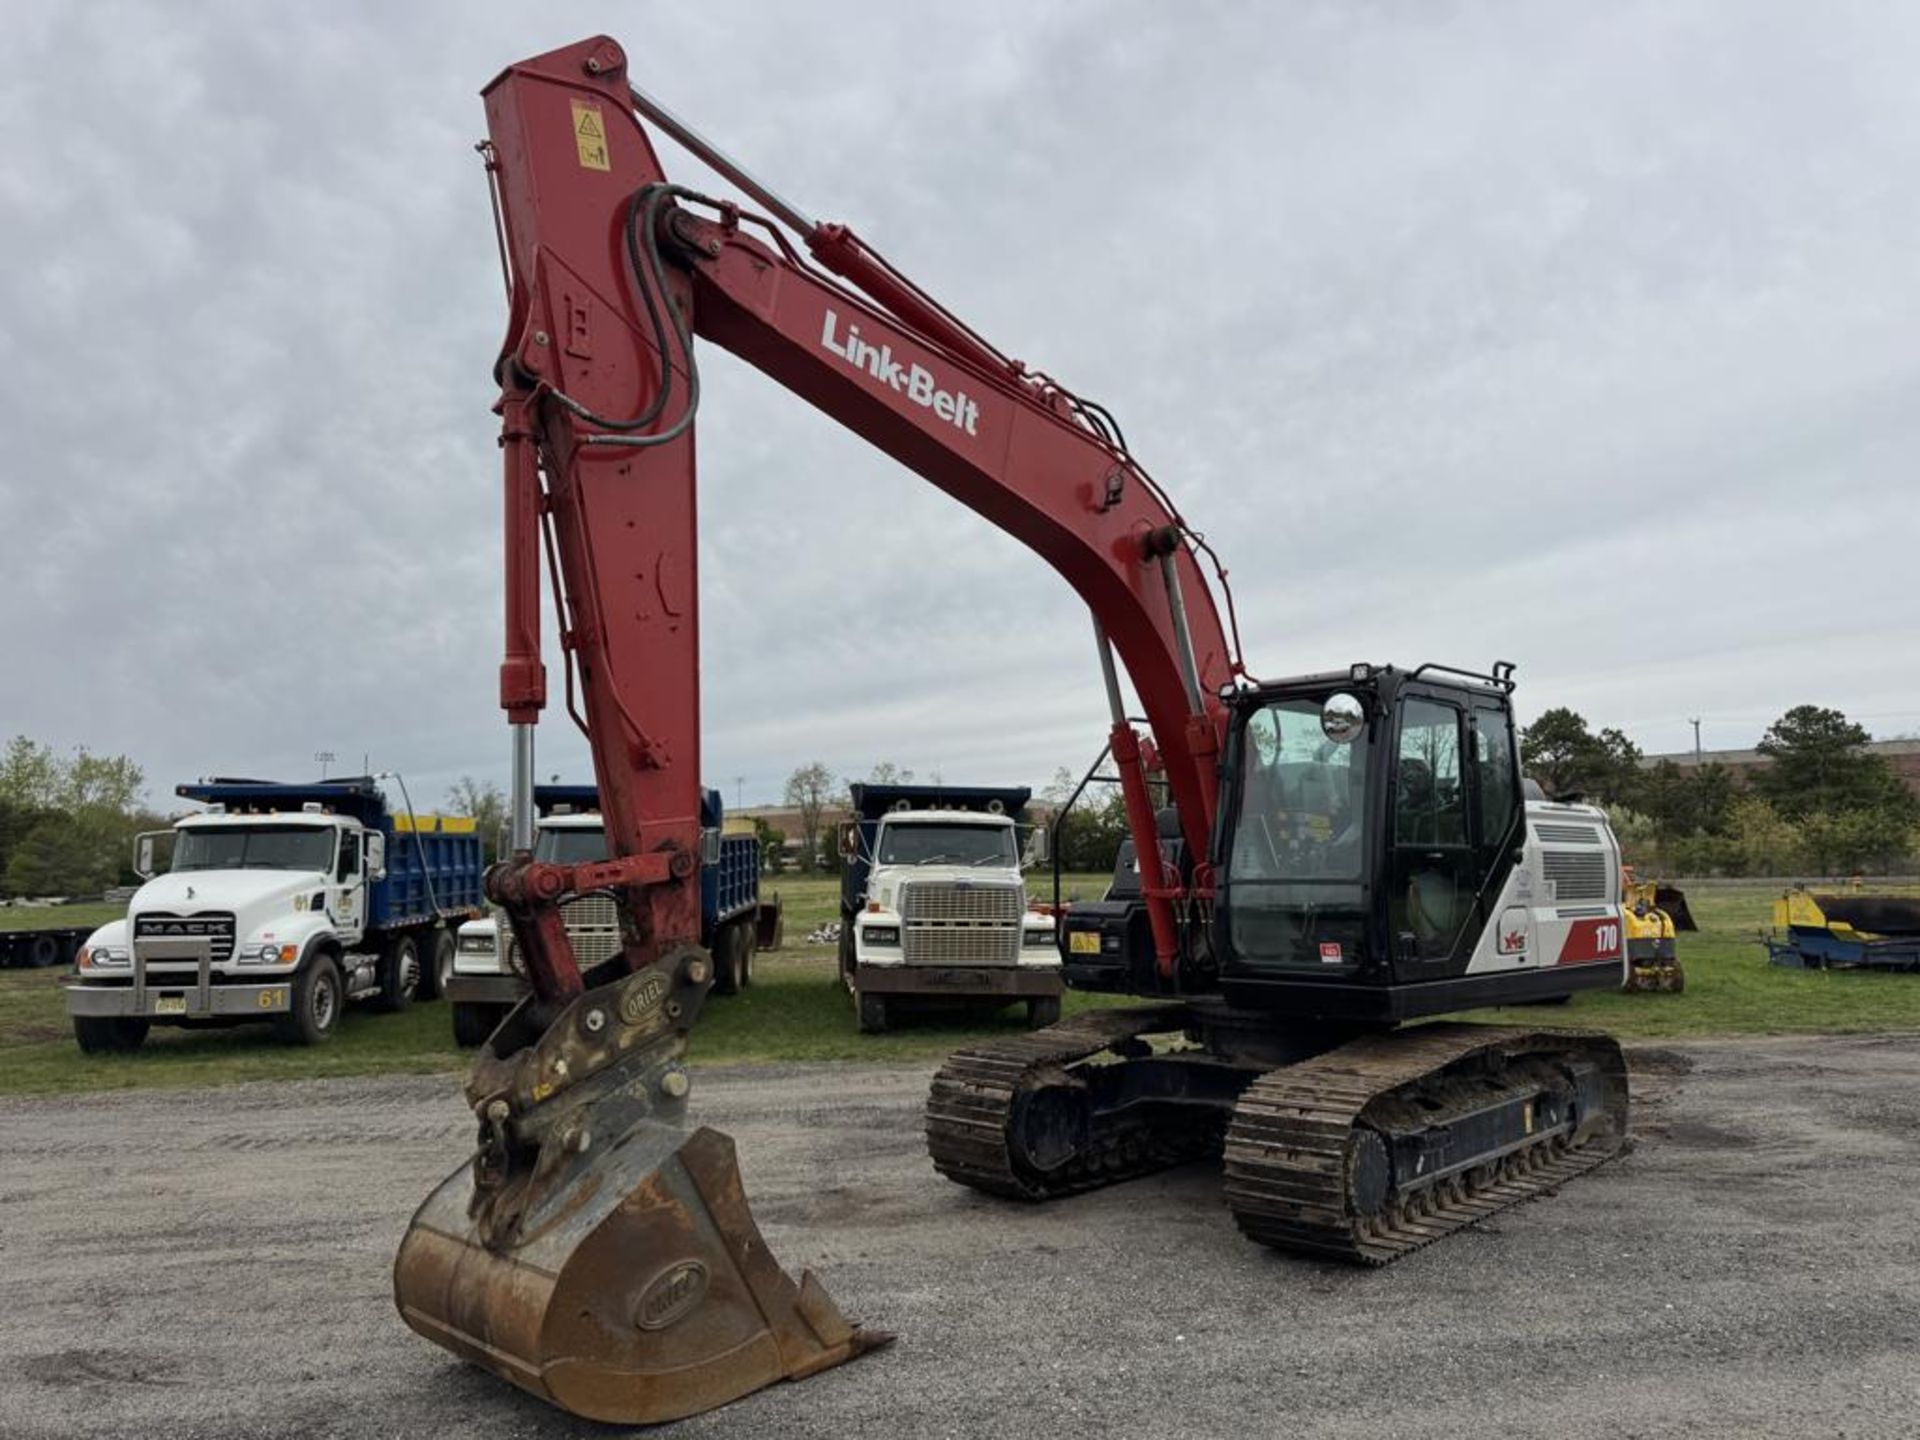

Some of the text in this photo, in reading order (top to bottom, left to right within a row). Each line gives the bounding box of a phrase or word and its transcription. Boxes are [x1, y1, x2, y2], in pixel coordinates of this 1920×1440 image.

[821, 309, 979, 436] Link-Belt
[142, 923, 228, 934] MACK
[1595, 924, 1617, 952] 170
[259, 990, 284, 1008] 61
